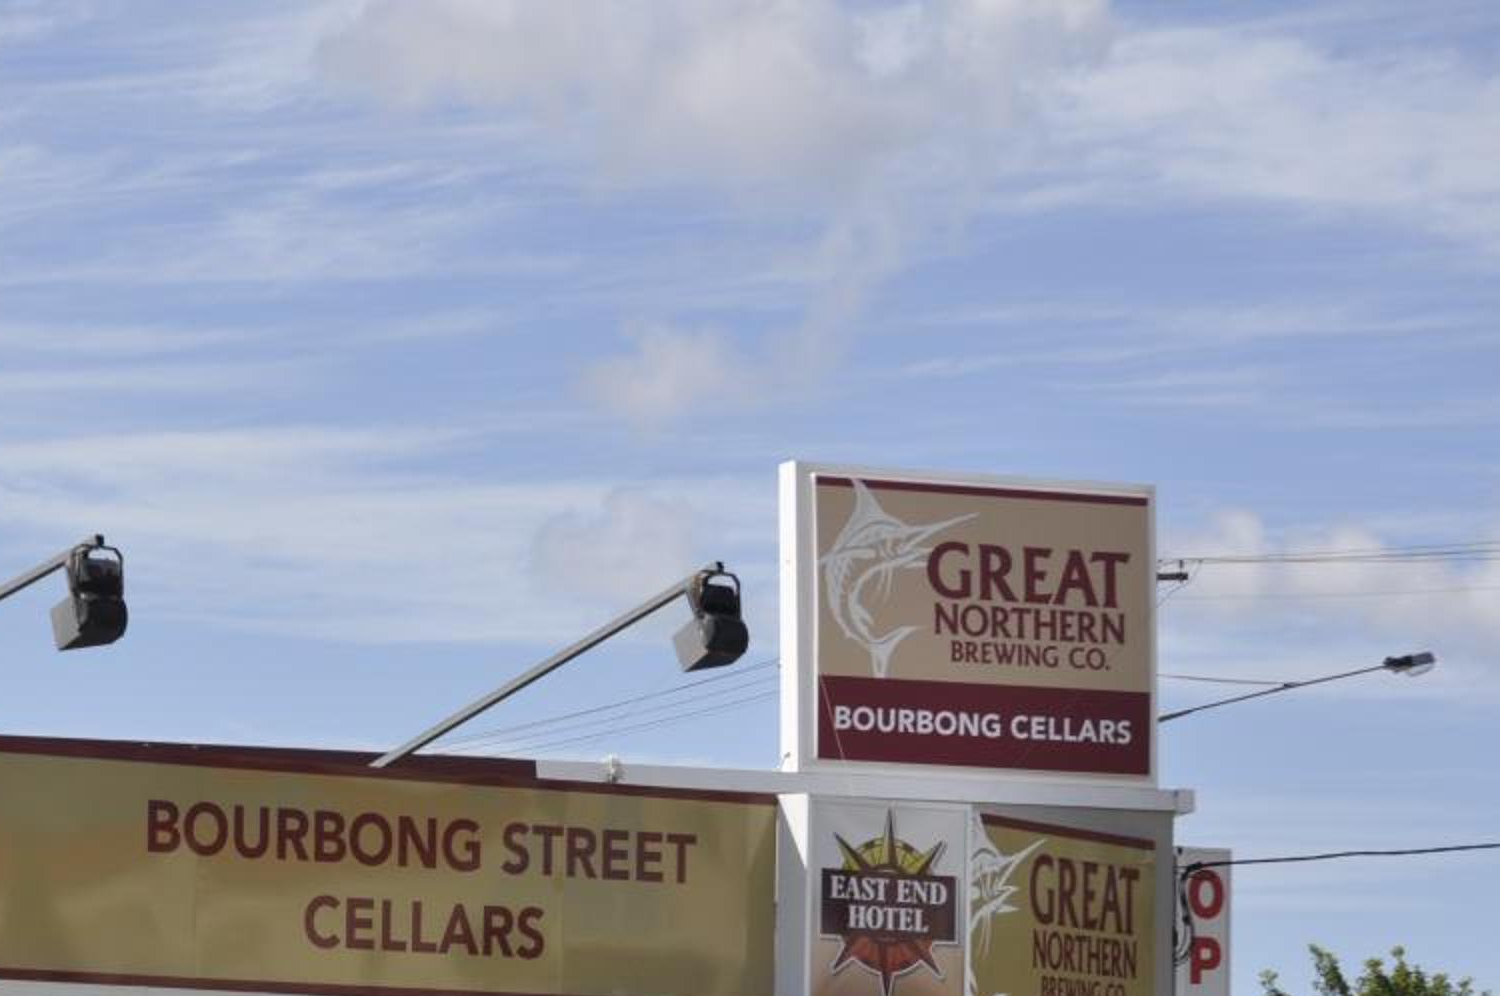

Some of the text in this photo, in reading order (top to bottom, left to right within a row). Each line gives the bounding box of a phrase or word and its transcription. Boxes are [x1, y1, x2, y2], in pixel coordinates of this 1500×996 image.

[926, 541, 1131, 609] GREAT
[934, 603, 1125, 645] NORTHERN
[951, 641, 1111, 671] BREWING CO.
[834, 706, 1132, 745] BOURBONG CELLARS
[146, 799, 698, 885] BOURBONG STREET
[830, 874, 948, 906] EAST END
[1029, 852, 1141, 936] GREAT
[304, 894, 546, 961] CELLARS
[847, 904, 930, 934] HOTEL
[1031, 928, 1138, 980] NORTHERN
